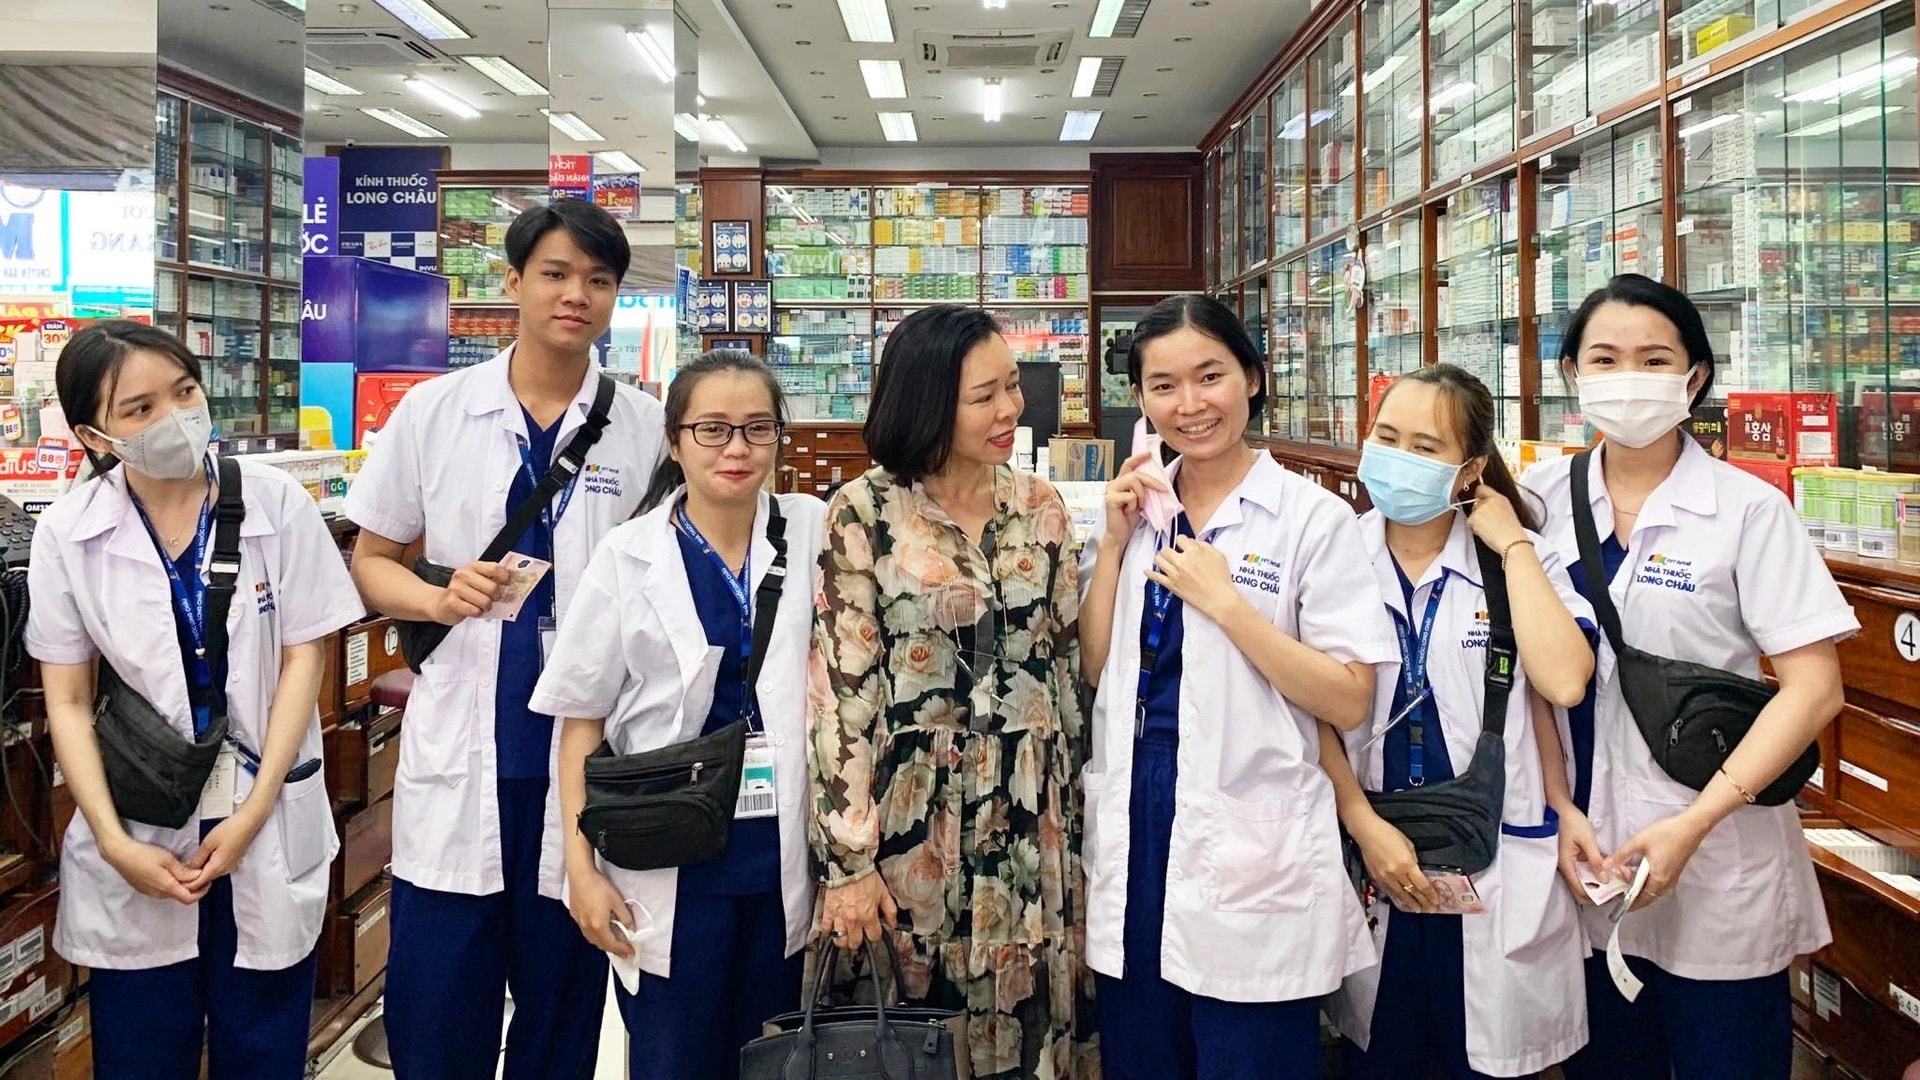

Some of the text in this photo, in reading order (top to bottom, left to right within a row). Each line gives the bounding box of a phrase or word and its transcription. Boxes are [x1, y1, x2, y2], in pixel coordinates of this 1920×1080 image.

[355, 173, 428, 187] KÍNH THUỐC
[346, 188, 437, 204] LONG CHÂU
[1751, 421, 1771, 441] 홍삼
[1257, 570, 1280, 583] THUỐC
[1644, 565, 1692, 580] NHÀ THUỐC
[1231, 574, 1280, 594] LONG CHÂU
[1637, 575, 1696, 593] LONG CHÂU
[1461, 638, 1487, 649] LONG
[1901, 620, 1916, 656] 4
[1418, 647, 1426, 665] THUỐC
